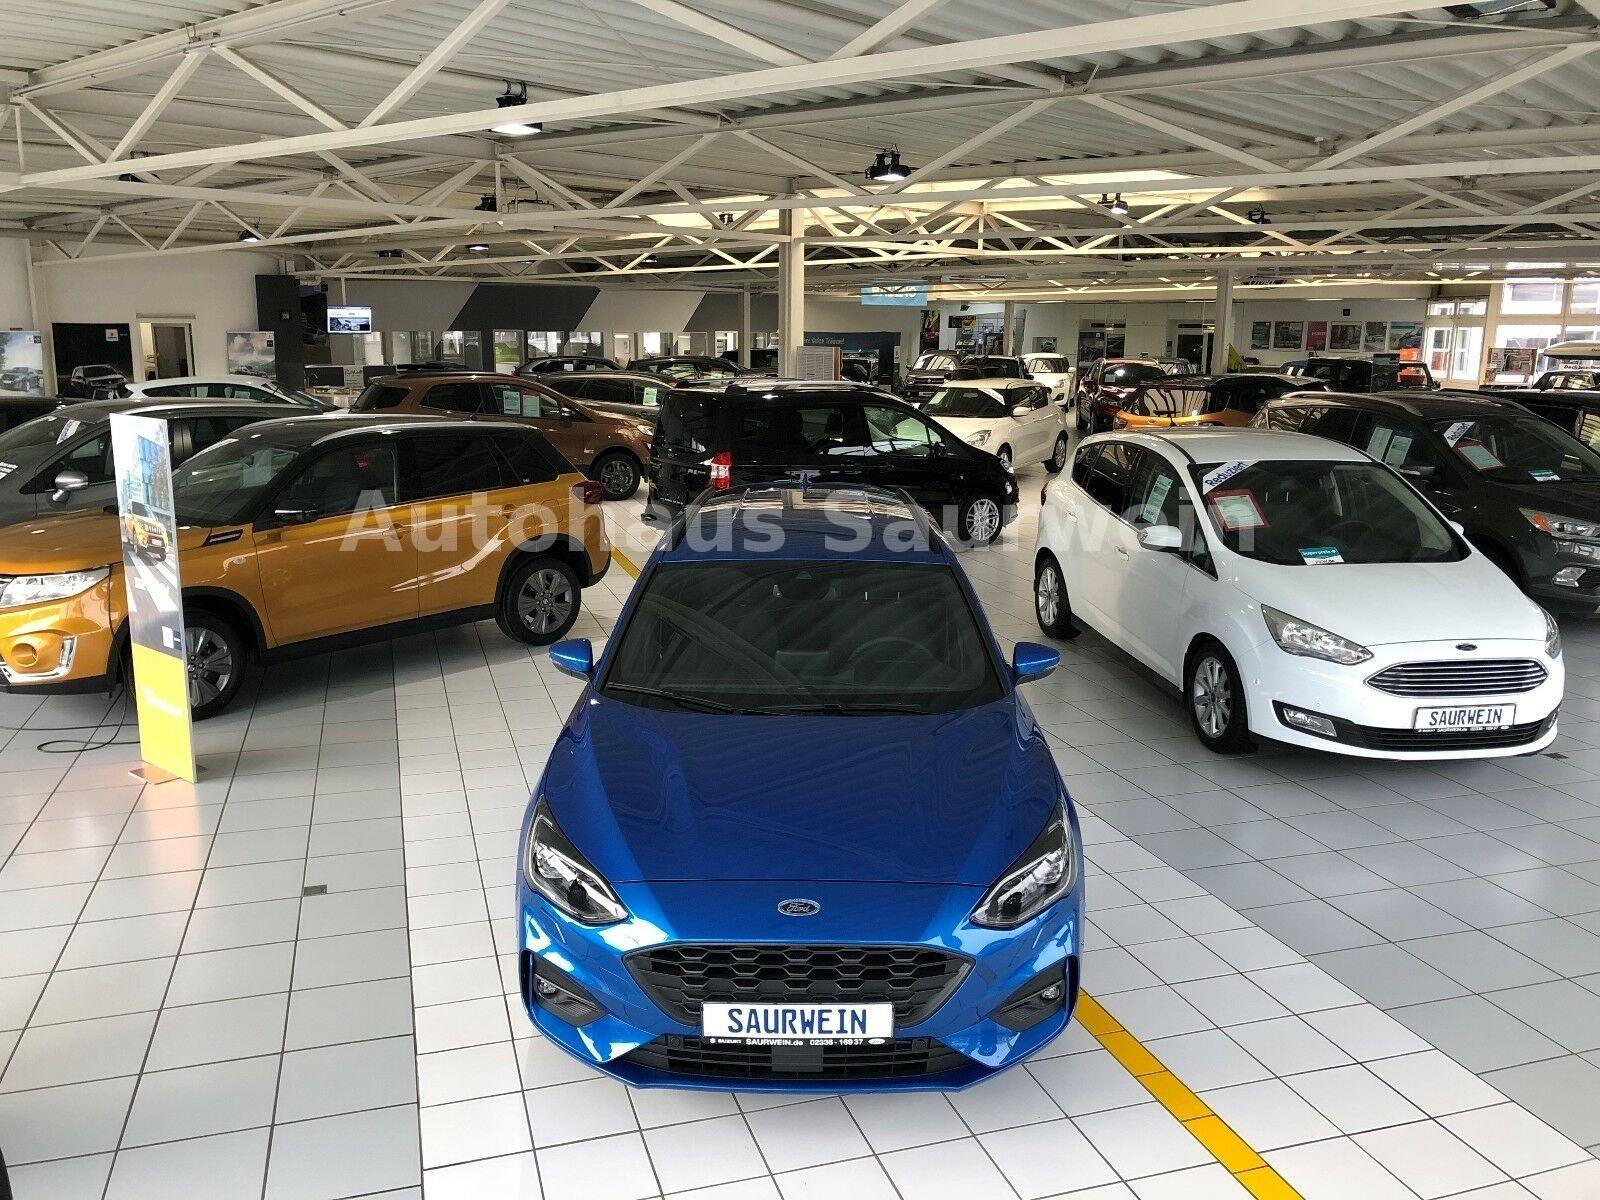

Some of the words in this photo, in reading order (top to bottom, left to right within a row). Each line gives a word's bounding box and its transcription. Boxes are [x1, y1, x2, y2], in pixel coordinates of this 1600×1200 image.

[1205, 461, 1249, 487] Reduziert
[1429, 708, 1502, 726] SAURWEIN
[727, 1008, 867, 1035] SAURWEIN
[745, 1038, 804, 1046] SAURWEIN.de
